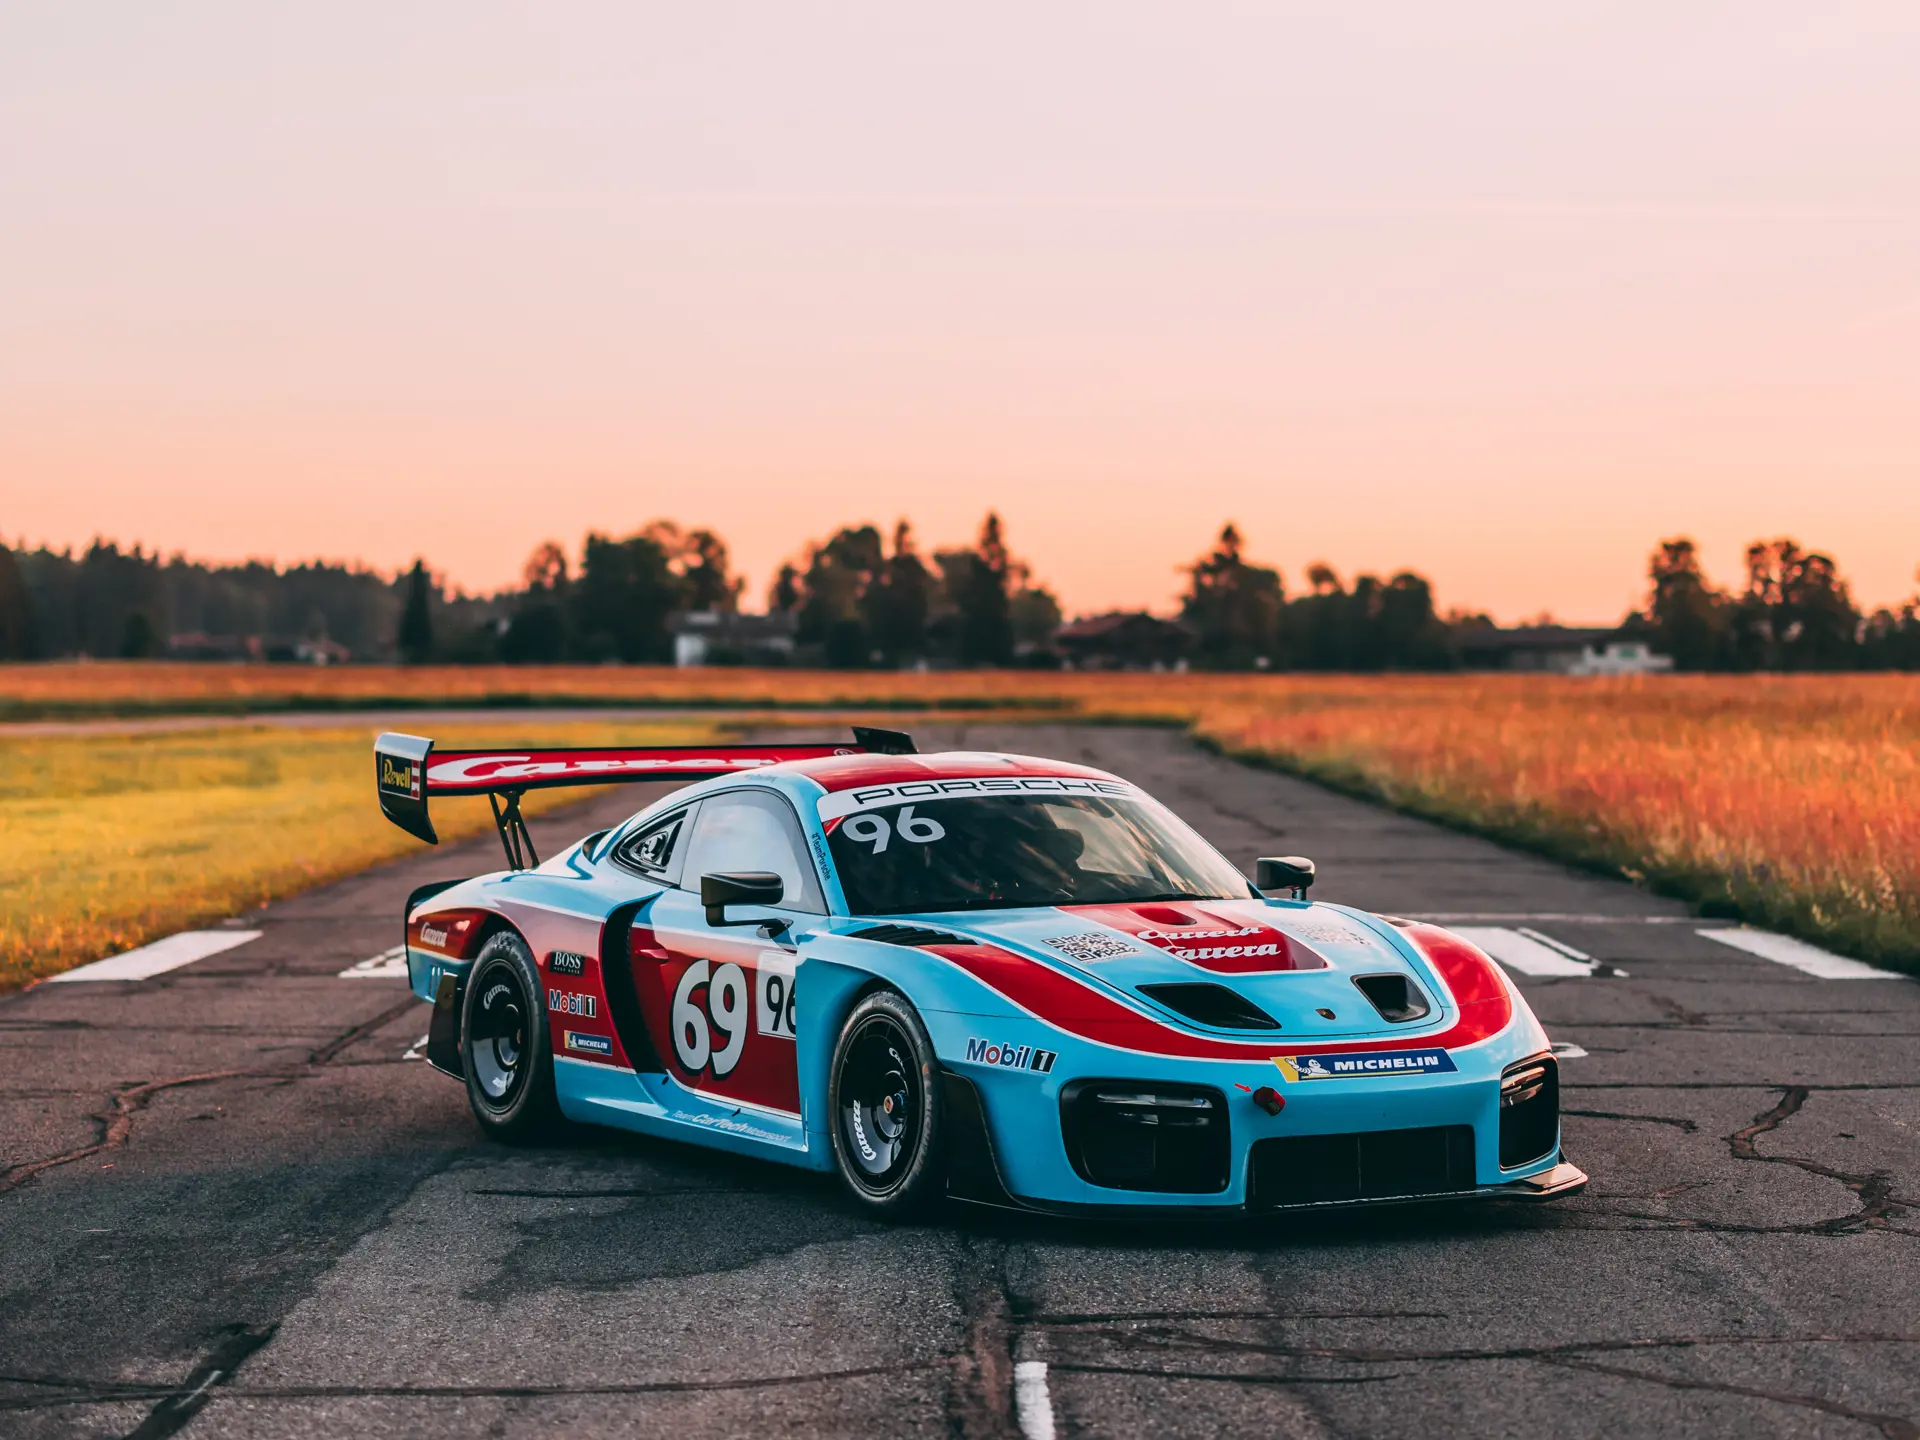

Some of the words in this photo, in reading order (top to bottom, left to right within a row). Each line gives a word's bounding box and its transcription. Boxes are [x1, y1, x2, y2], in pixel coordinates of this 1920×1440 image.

[384, 758, 411, 789] Revell
[427, 756, 777, 782] Carrer
[852, 780, 1134, 804] PORSCHE
[841, 806, 946, 854] 96
[811, 832, 831, 881] #TeamPorsche
[1137, 927, 1264, 941] Carrera
[554, 951, 582, 969] BOSS
[483, 984, 512, 1010] Carrera
[549, 989, 584, 1015] Mobil
[670, 958, 748, 1081] 69
[577, 1038, 608, 1050] MICHELIN
[966, 1037, 1032, 1070] Mobil
[1334, 1056, 1439, 1071] MICHELIN
[853, 1100, 876, 1161] Carrera
